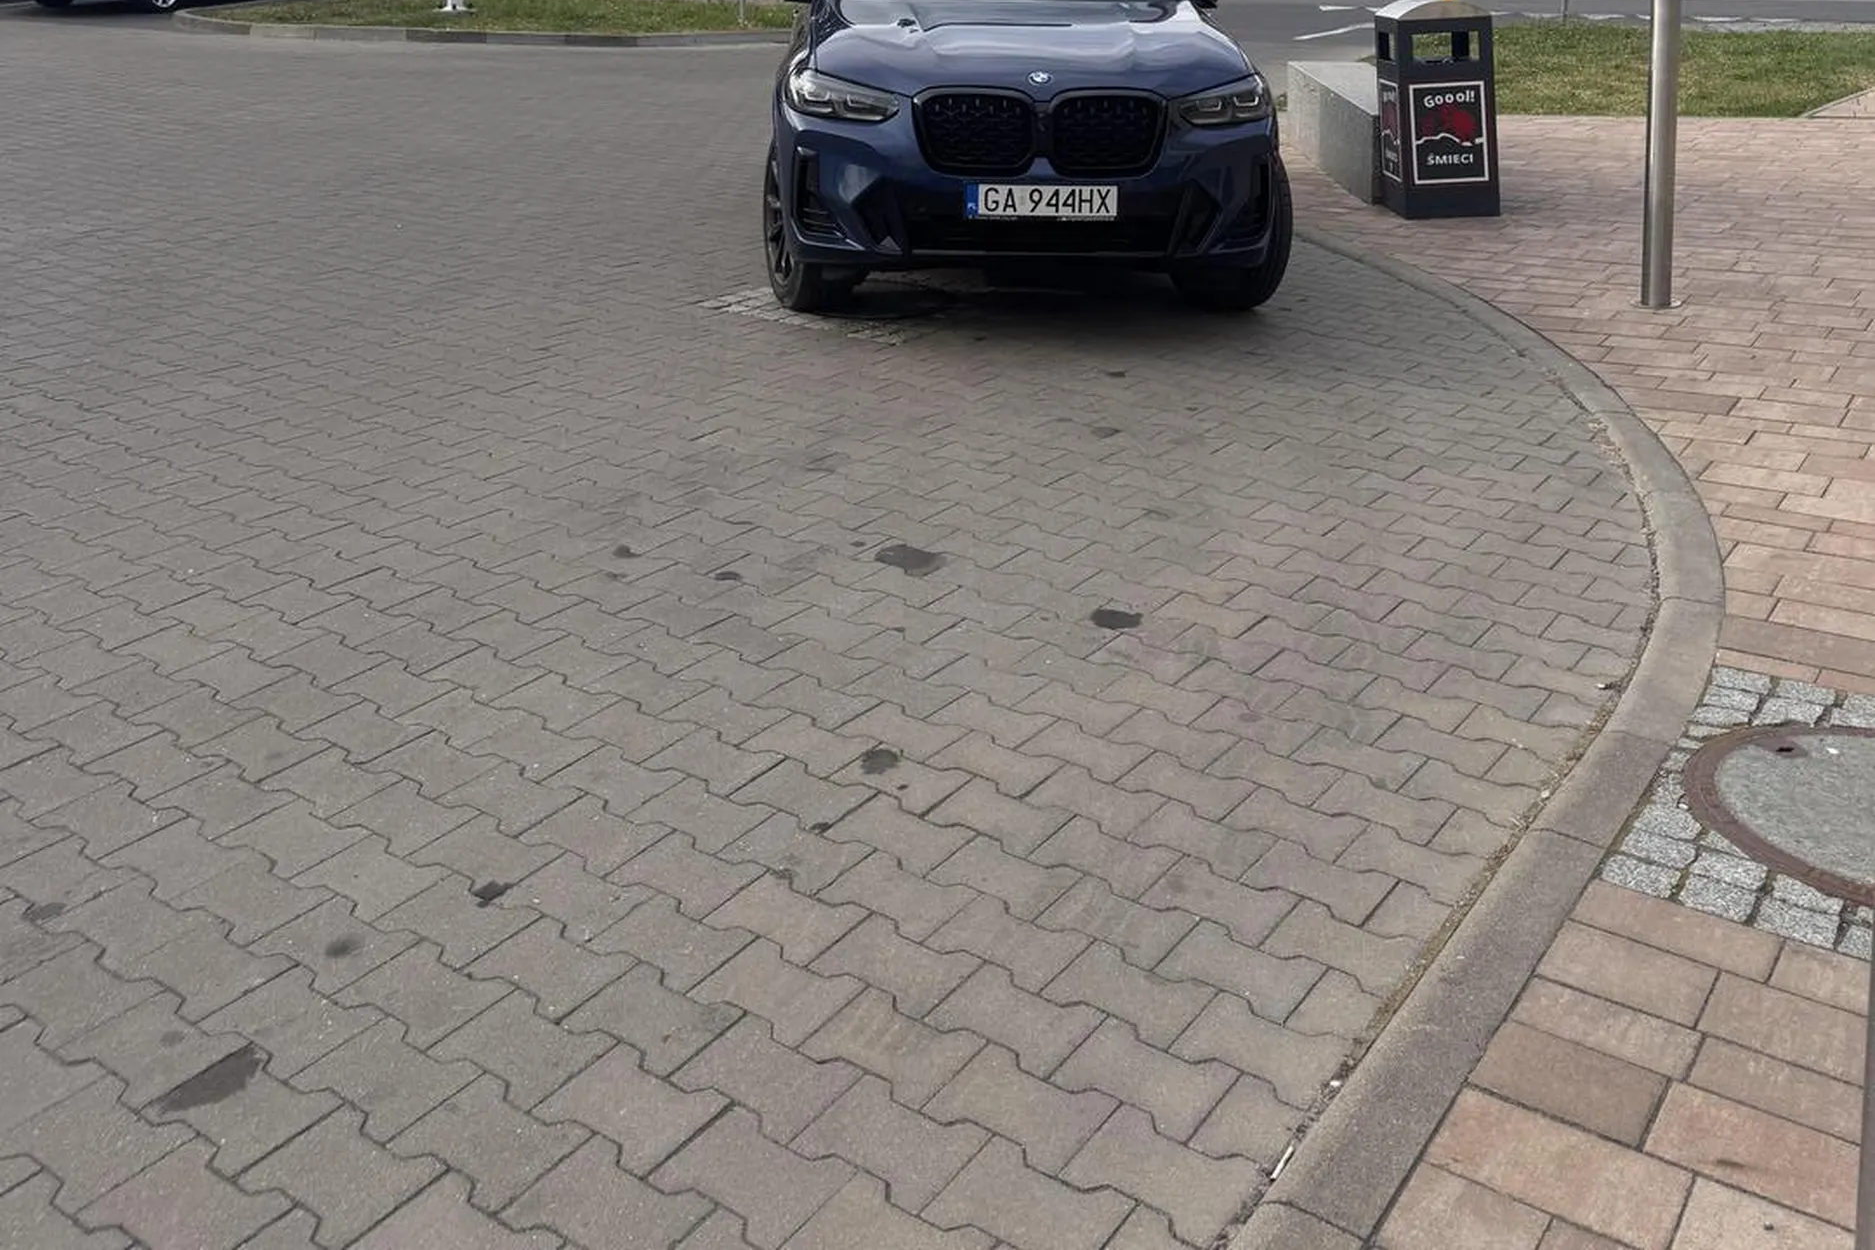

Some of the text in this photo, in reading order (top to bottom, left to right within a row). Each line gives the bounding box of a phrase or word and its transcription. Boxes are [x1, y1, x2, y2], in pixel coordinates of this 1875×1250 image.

[1423, 90, 1475, 108] Goool!
[1426, 152, 1473, 165] ŚMIECI
[984, 187, 1111, 213] GA 944HX
